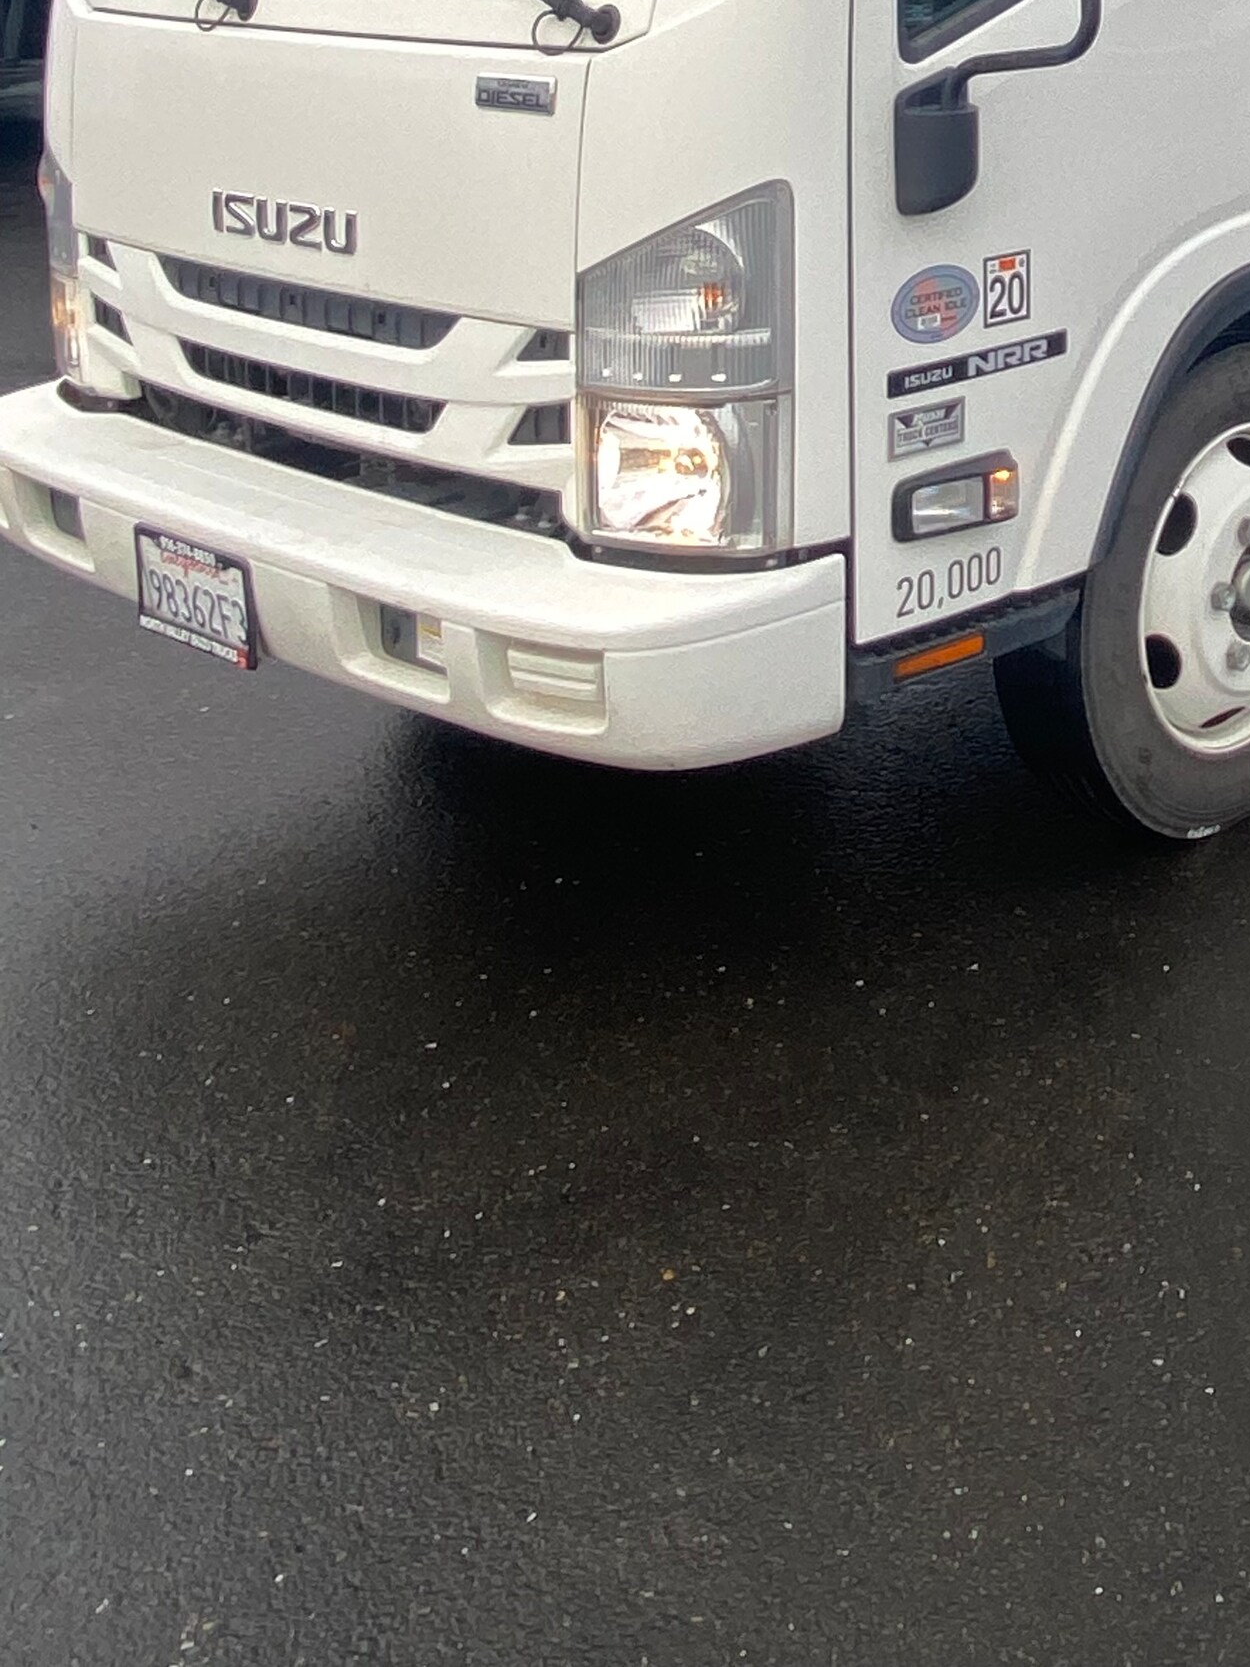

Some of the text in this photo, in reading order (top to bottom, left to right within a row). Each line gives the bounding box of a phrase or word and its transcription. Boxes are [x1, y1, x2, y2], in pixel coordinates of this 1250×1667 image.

[479, 90, 548, 110] DIESEL
[212, 187, 358, 256] ISUZU
[905, 298, 967, 319] CLEAN IDLE
[910, 287, 963, 306] CERTIFIED
[989, 270, 1025, 320] 20
[904, 339, 1049, 389] ISUZU NRR
[896, 546, 1001, 618] 20,000
